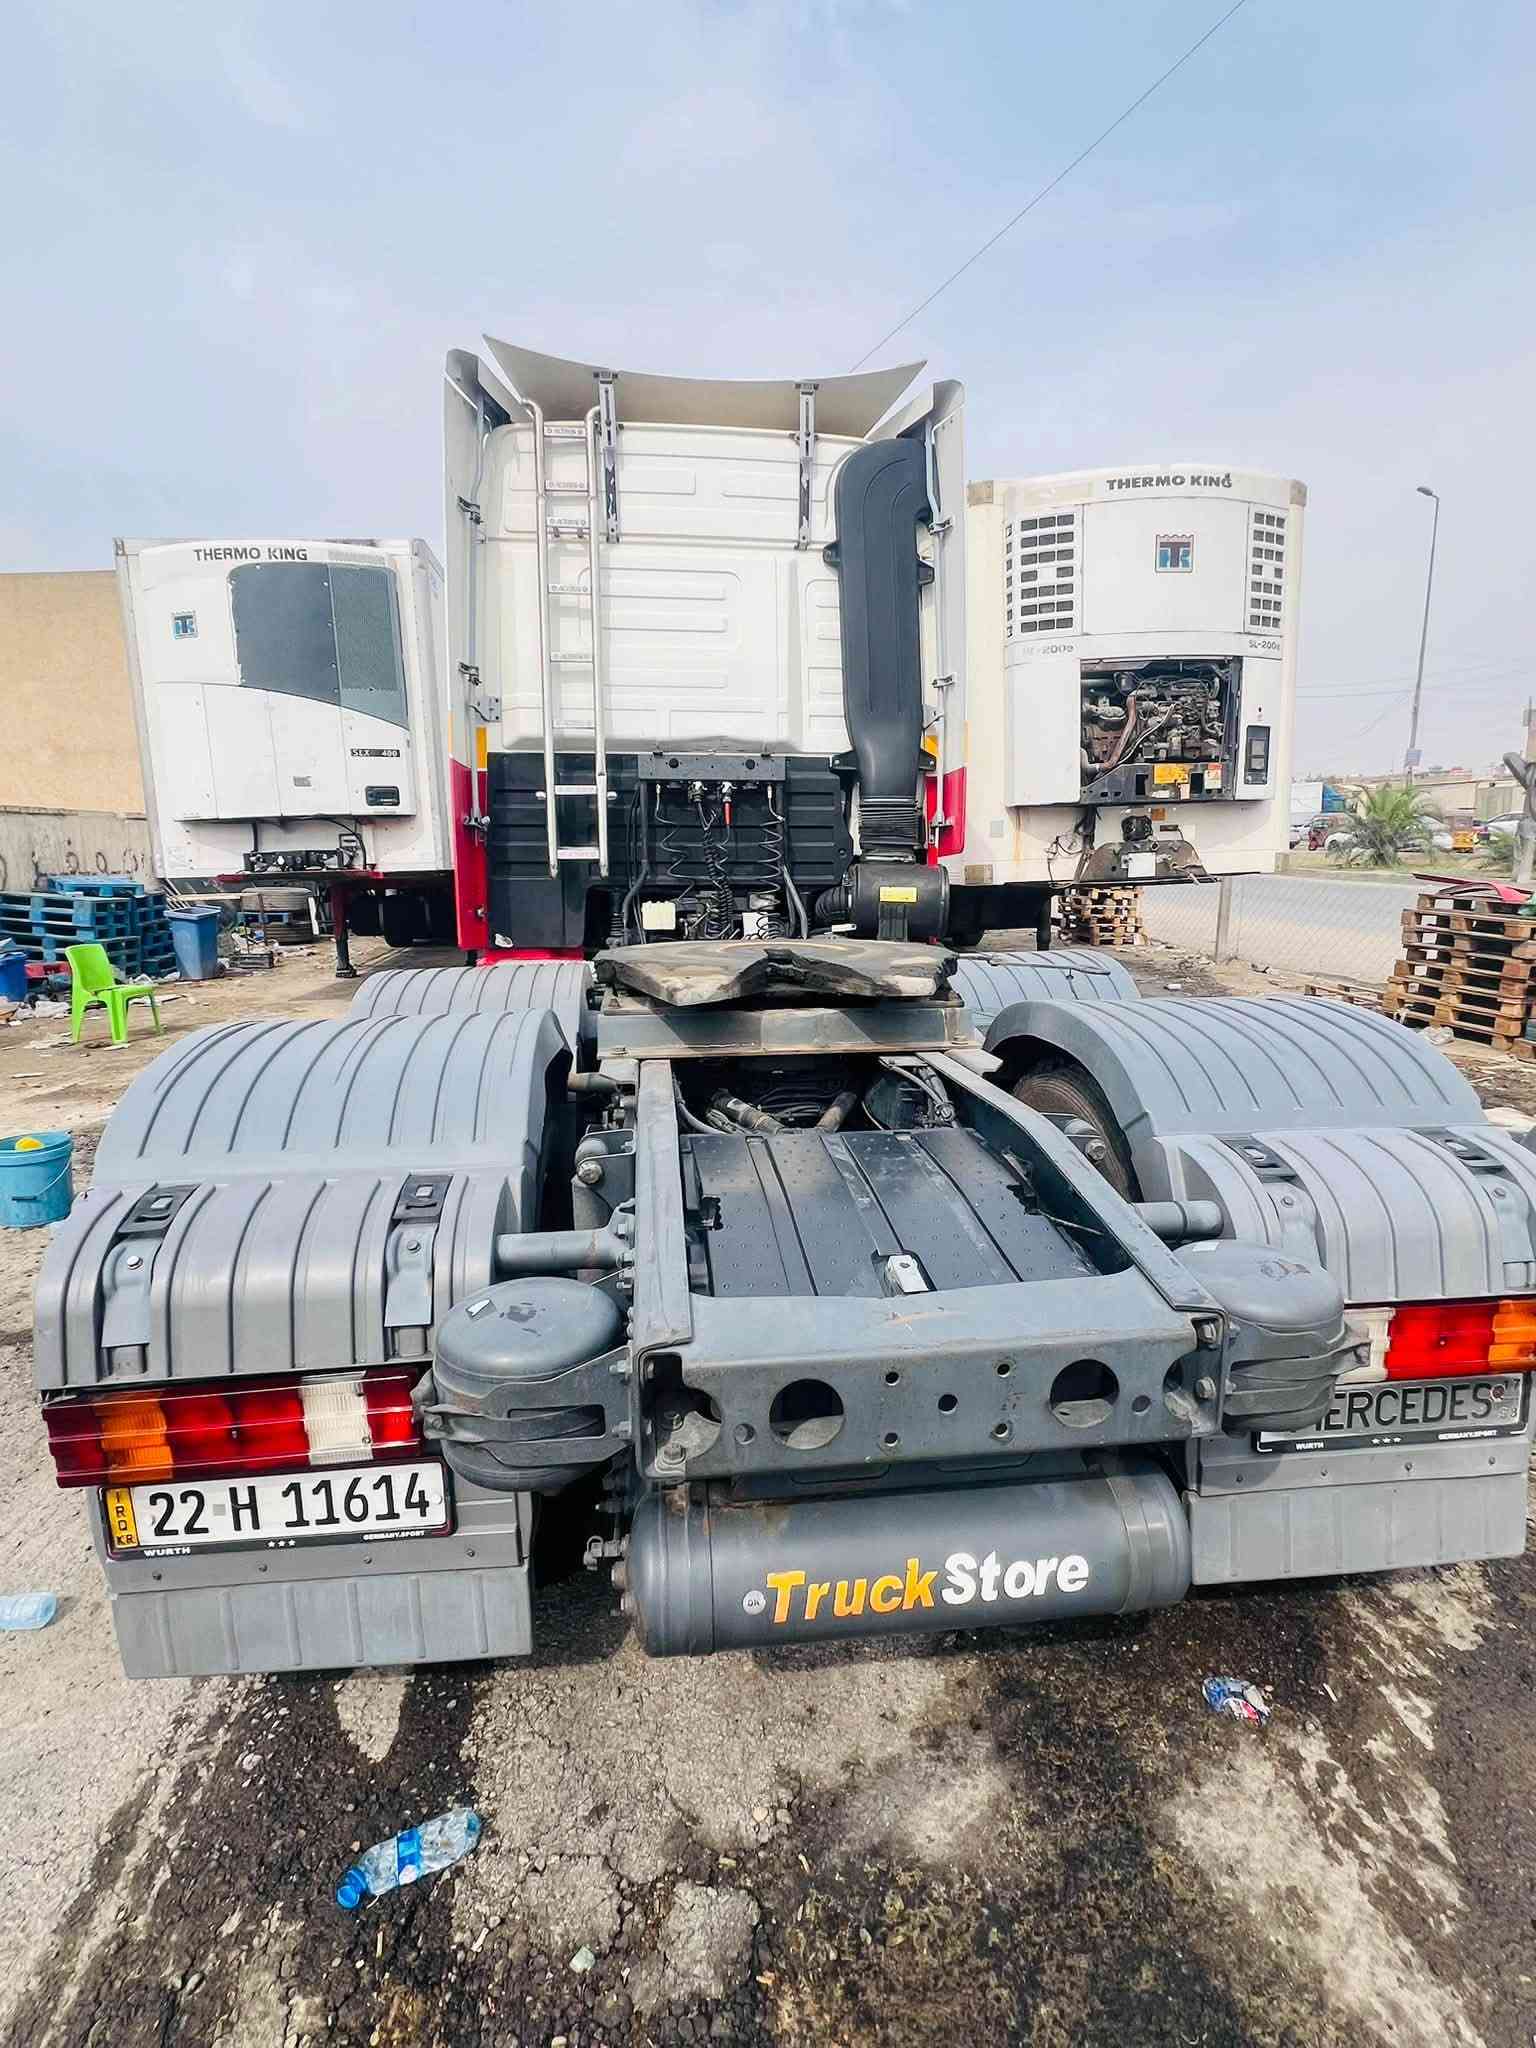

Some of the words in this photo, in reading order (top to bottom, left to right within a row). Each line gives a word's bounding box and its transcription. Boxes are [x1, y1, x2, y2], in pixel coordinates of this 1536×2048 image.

[1106, 475, 1186, 490] THERMO
[1190, 473, 1232, 488] KING
[194, 547, 261, 561] THERMO
[268, 547, 308, 561] KING
[1315, 1383, 1493, 1431] ERCEDES
[149, 1489, 209, 1536] 22
[228, 1485, 260, 1531] H
[281, 1472, 430, 1528] 11614
[143, 1547, 192, 1557] WURTH
